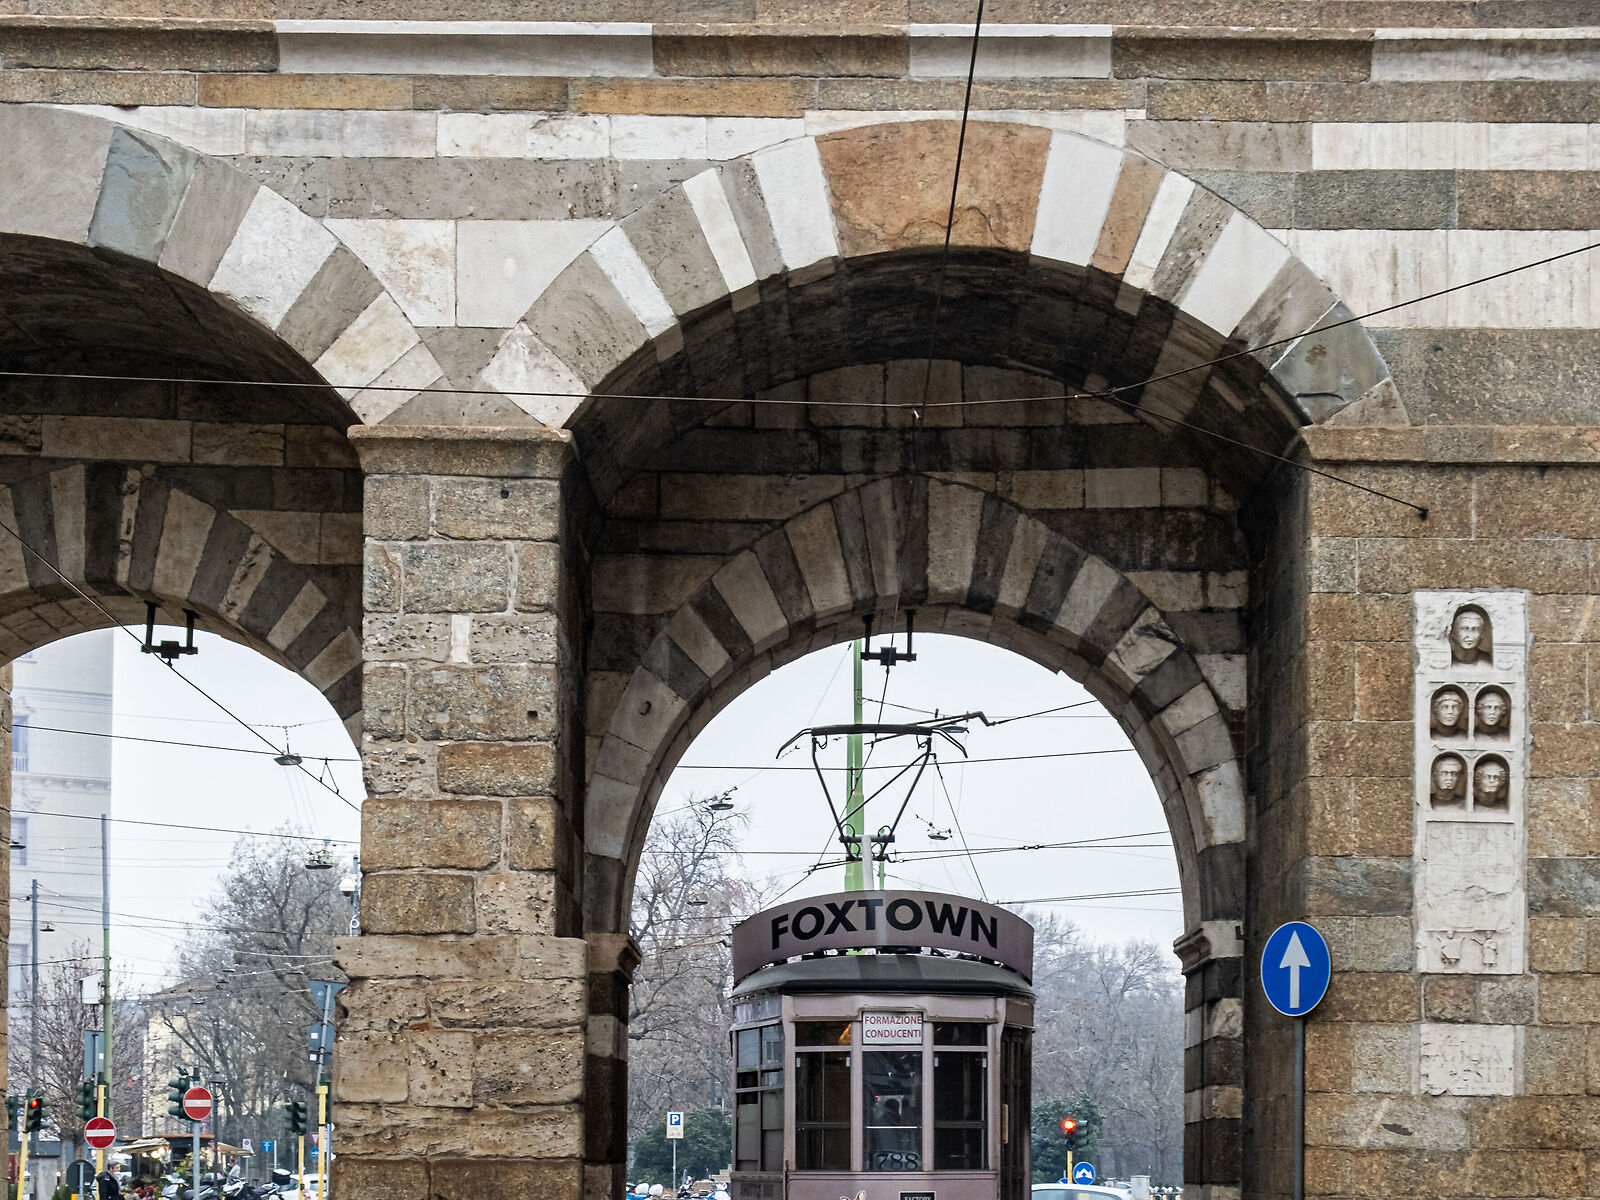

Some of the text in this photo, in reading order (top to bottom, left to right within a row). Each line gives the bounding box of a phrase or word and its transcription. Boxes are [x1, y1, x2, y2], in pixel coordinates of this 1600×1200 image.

[771, 898, 998, 950] FOXTOWN
[864, 1015, 922, 1025] FORMAZIONE
[865, 1029, 922, 1039] CONDUCENTI
[672, 1115, 680, 1124] P
